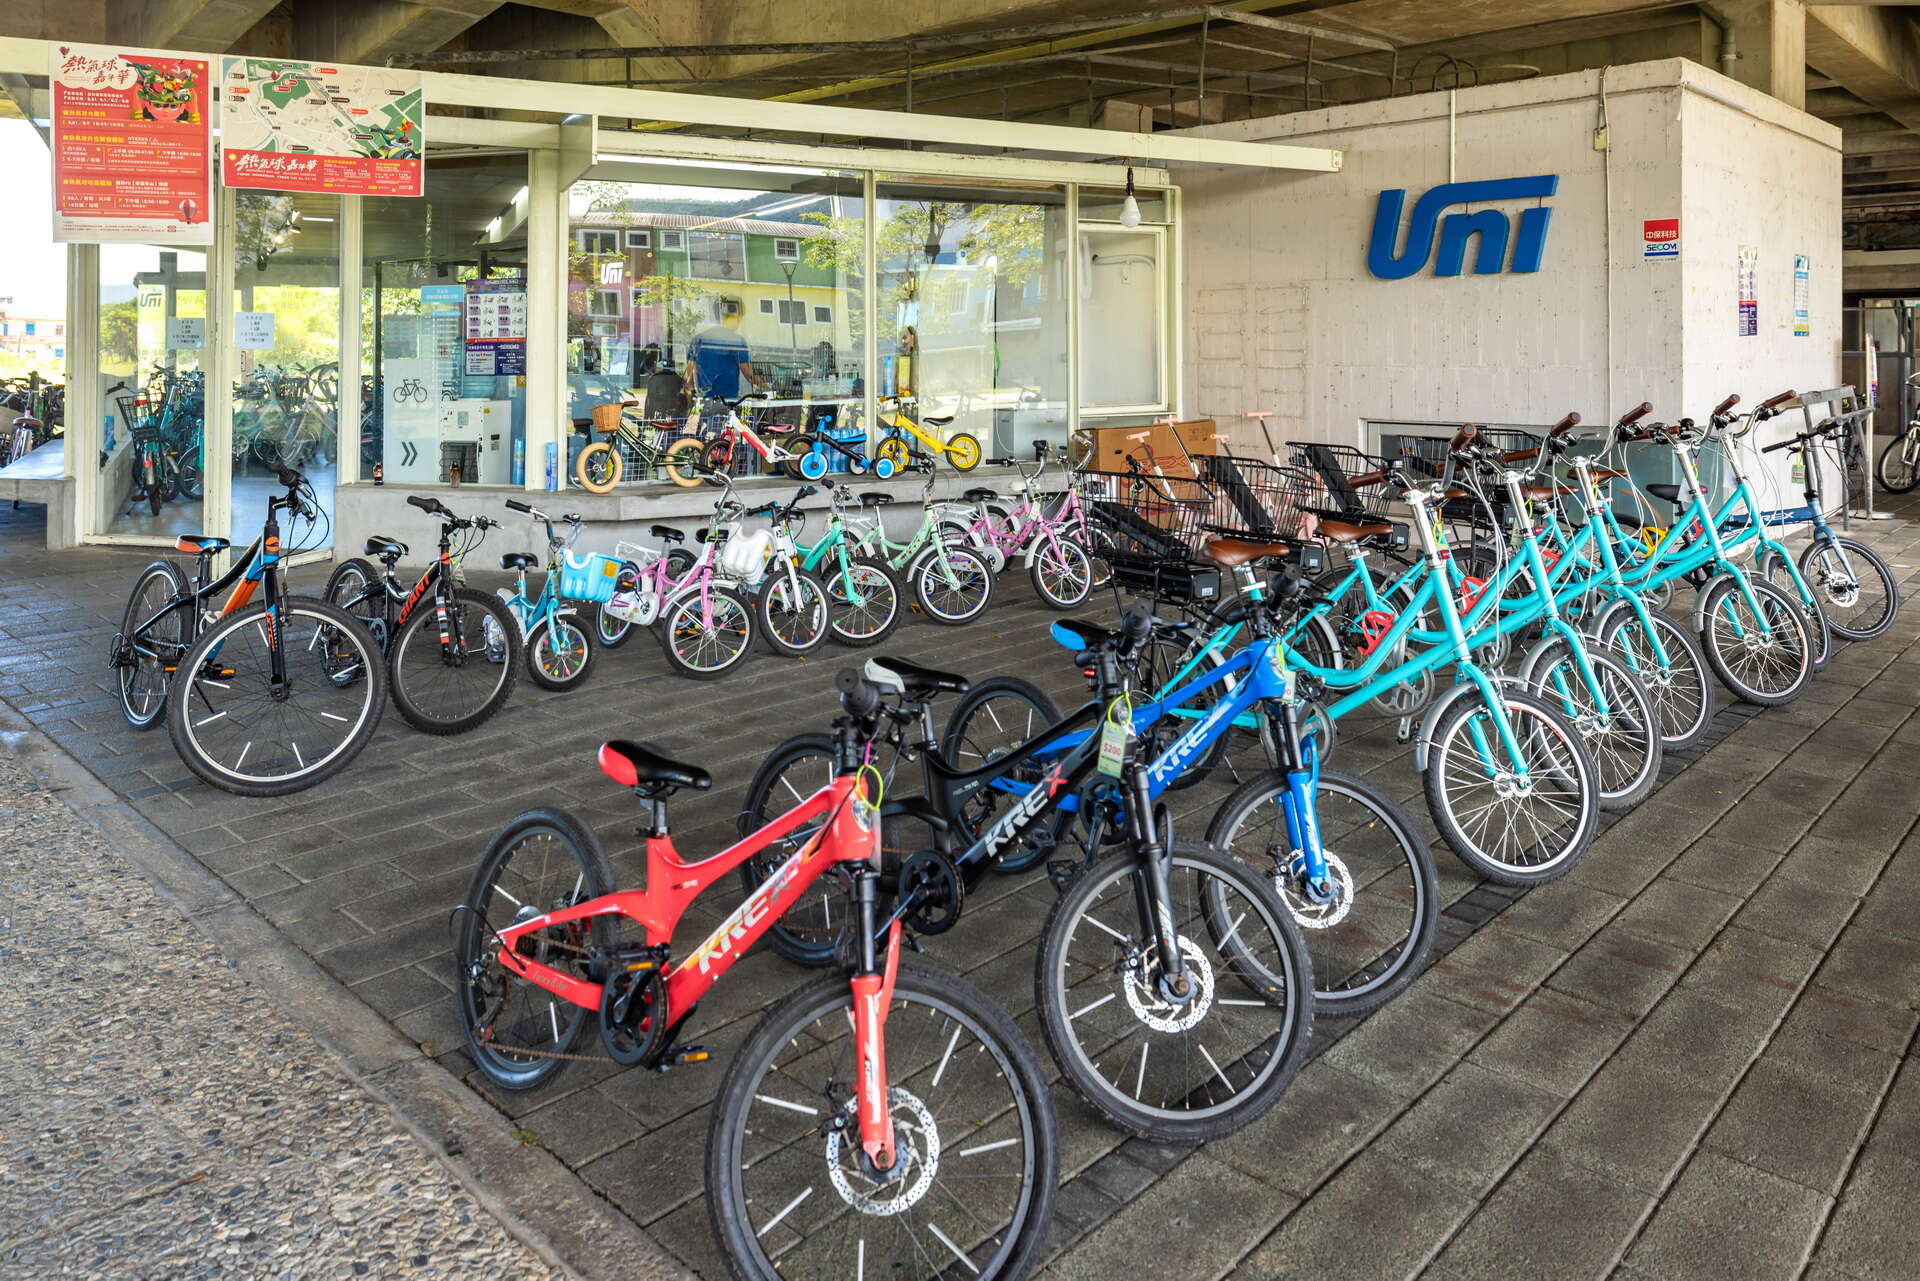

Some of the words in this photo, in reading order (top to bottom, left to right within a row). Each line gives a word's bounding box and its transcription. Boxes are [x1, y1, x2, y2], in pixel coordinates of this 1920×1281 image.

[62, 55, 119, 74] 熱氣球
[1646, 230, 1677, 239] 中保科技
[1646, 243, 1677, 251] SECOM
[399, 575, 430, 624] GIANT
[985, 764, 1069, 858] KREX
